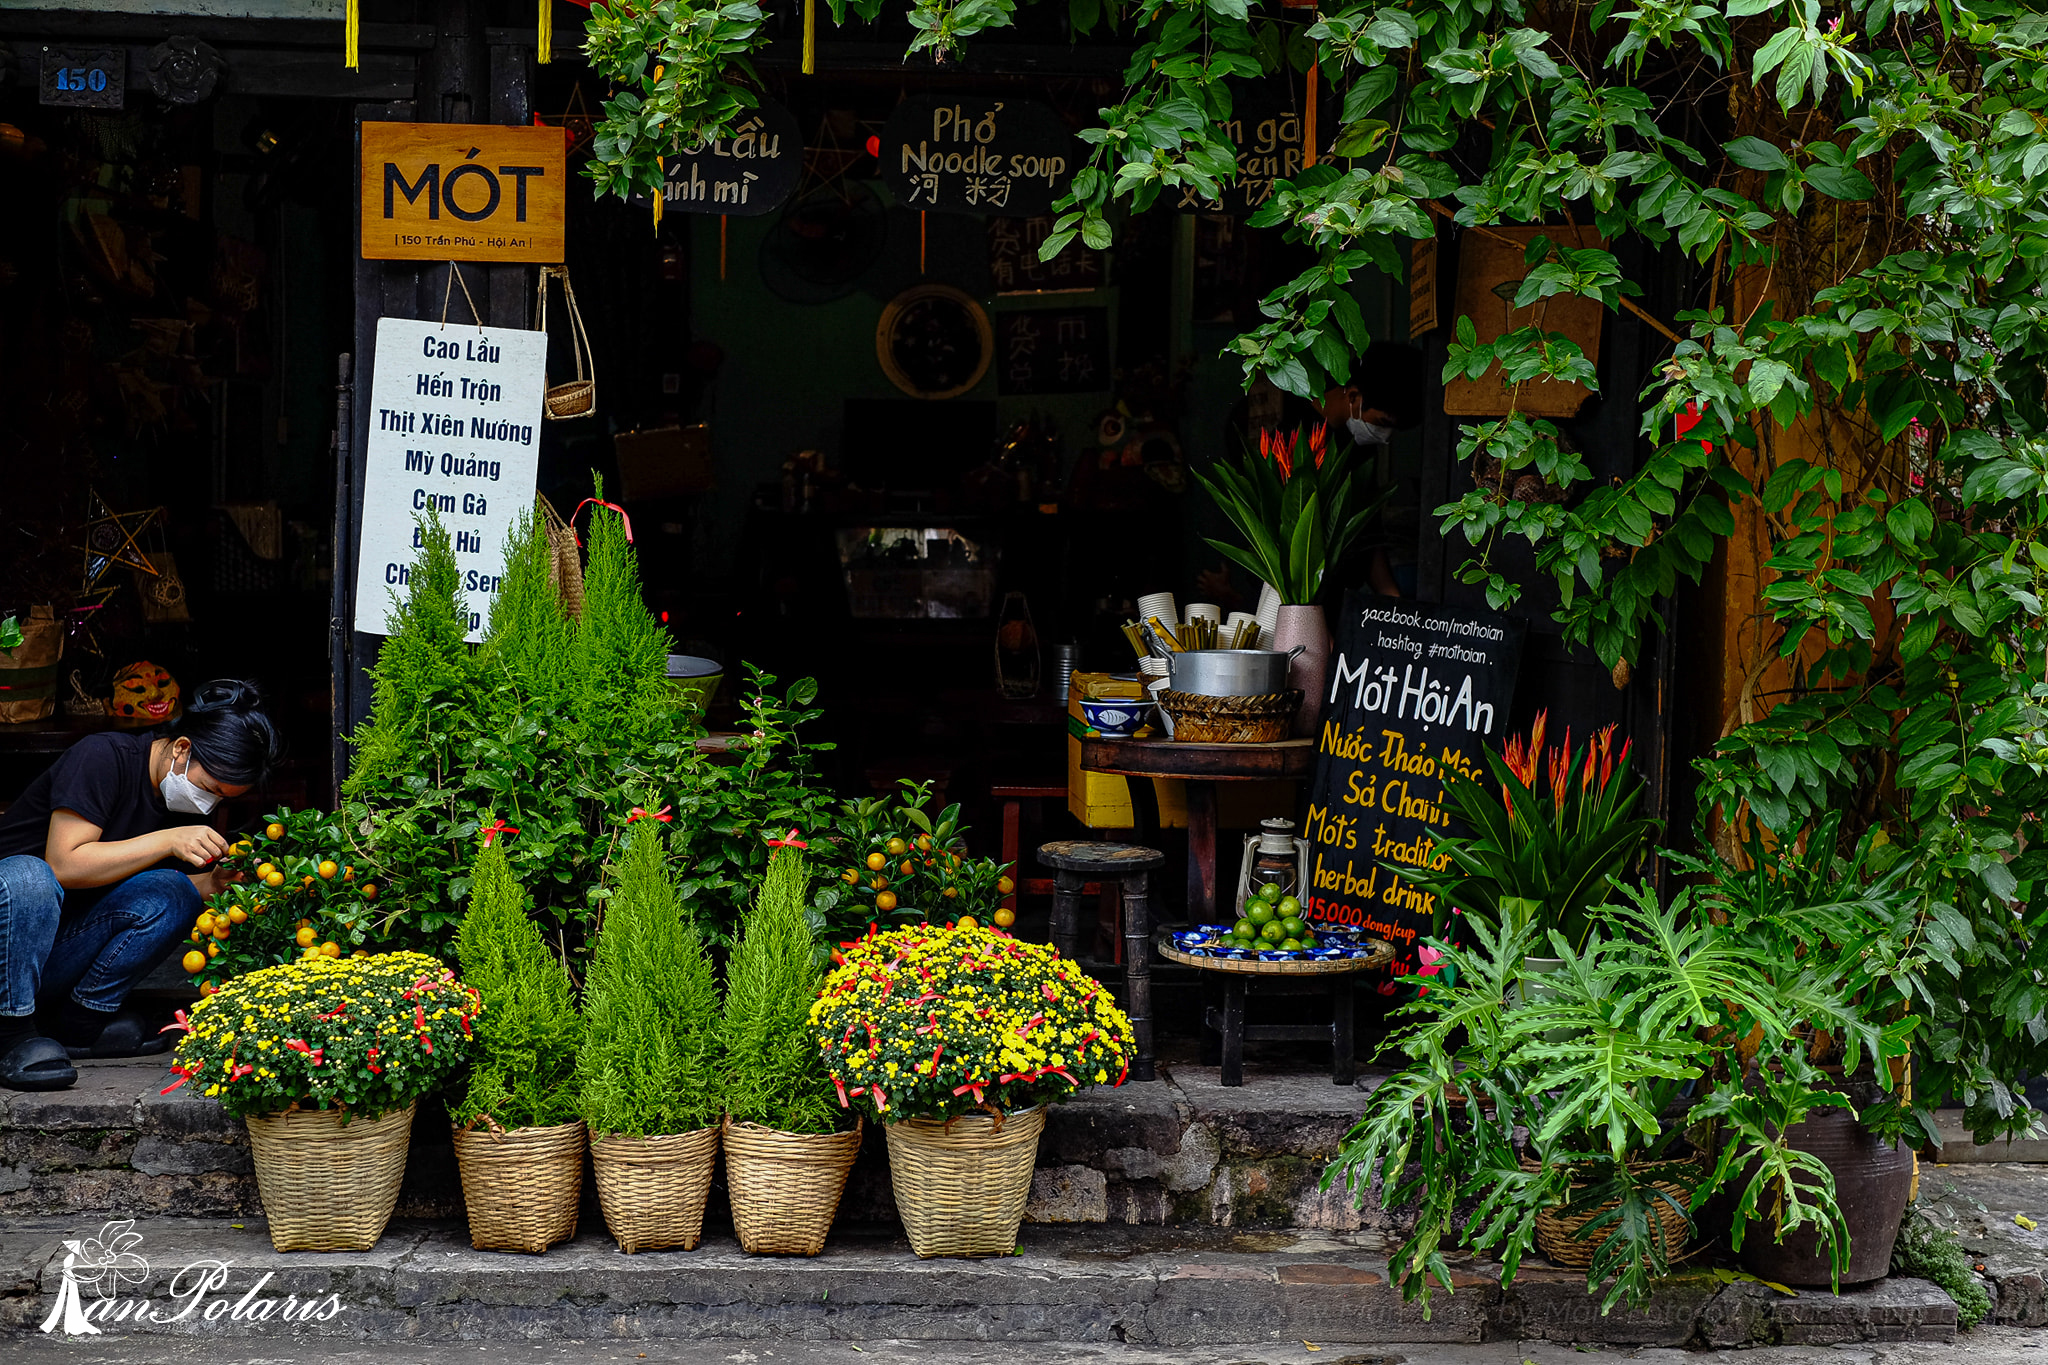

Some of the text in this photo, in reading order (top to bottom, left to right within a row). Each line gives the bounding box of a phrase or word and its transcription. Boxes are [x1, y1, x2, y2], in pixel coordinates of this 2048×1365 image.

[56, 68, 107, 92] 150
[933, 101, 1005, 144] Phở
[901, 140, 1066, 188] Noodle soup
[383, 147, 544, 223] MÓT
[401, 234, 422, 246] 150
[509, 238, 526, 248] An
[423, 336, 501, 364] Cao Lầu
[416, 371, 501, 406] Hến Trộn
[379, 409, 533, 446] Thịt Xiên Nướng
[405, 450, 501, 482] Mỳ Quảng
[462, 493, 488, 516] Gà
[456, 529, 481, 554] Hủ
[1377, 630, 1423, 660] hashtag
[1329, 652, 1399, 715] Mót
[1319, 719, 1374, 763] Nước
[1378, 728, 1436, 778] Thảo
[1343, 770, 1377, 808] Sả
[1313, 852, 1437, 916] herbal drink
[1362, 913, 1417, 946] dong/cup
